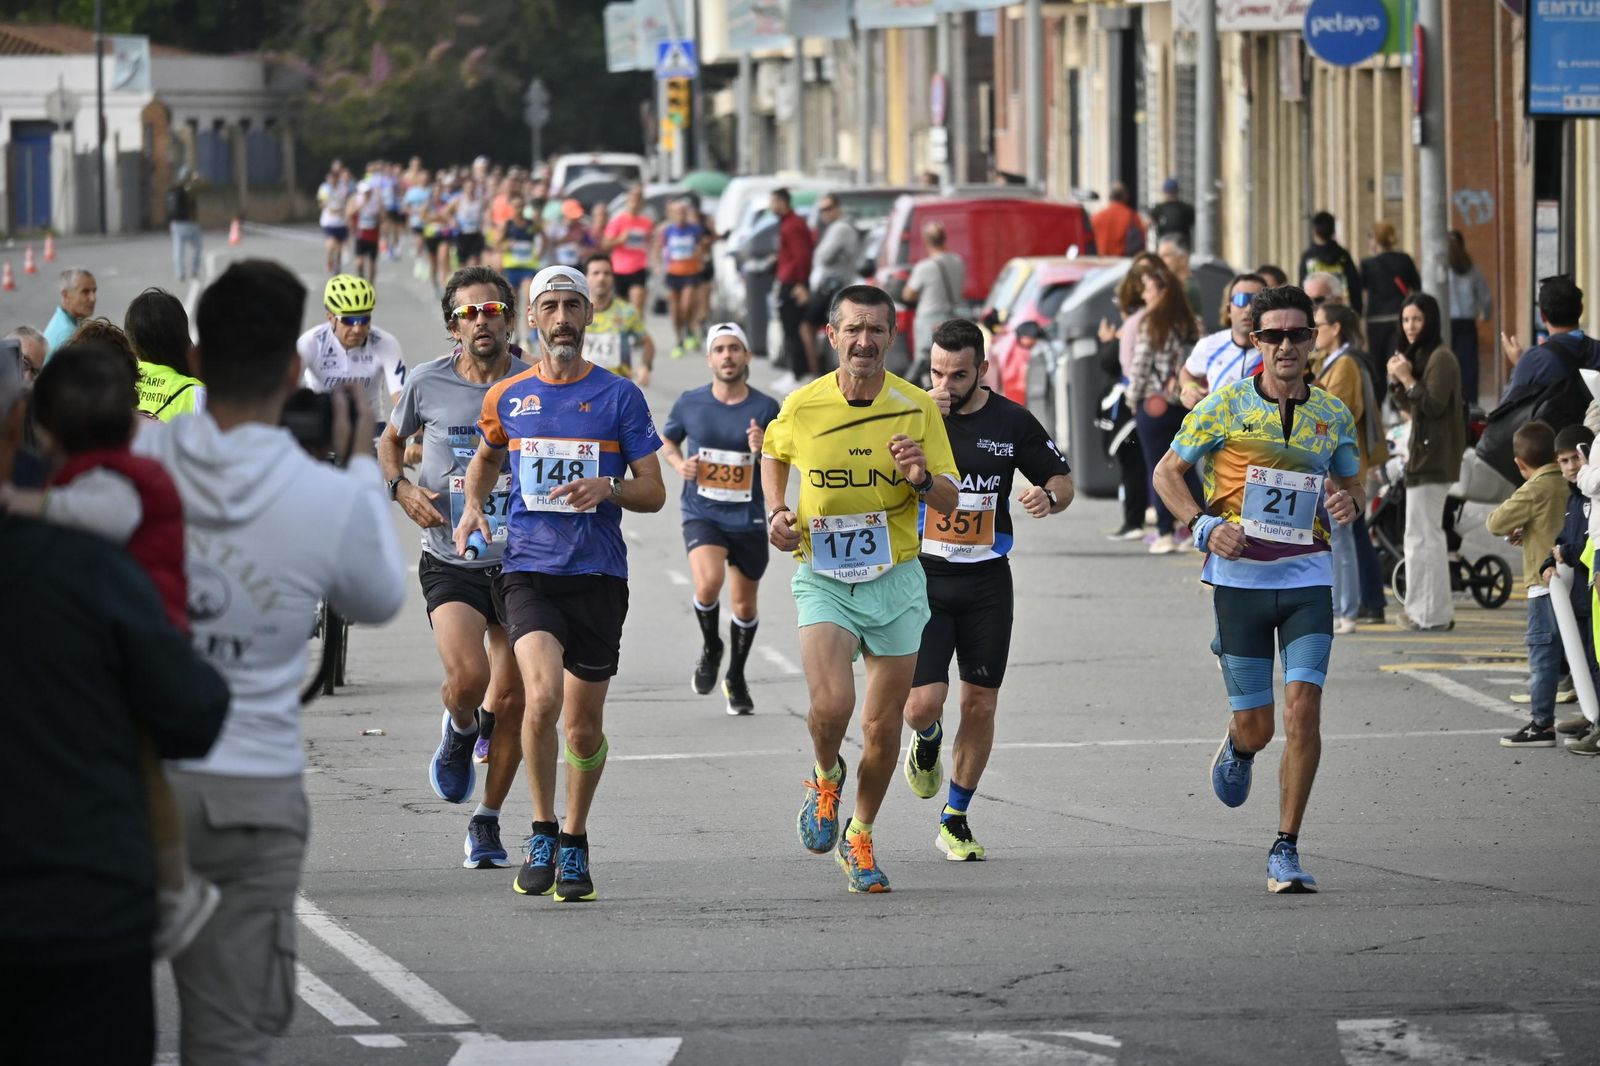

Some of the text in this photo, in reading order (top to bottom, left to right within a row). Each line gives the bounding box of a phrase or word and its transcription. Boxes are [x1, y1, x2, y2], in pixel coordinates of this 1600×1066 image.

[1311, 12, 1380, 37] pelayo
[849, 448, 873, 456] vive
[531, 458, 584, 485] 148
[706, 463, 744, 483] 239
[1263, 488, 1297, 516] 21
[936, 510, 982, 535] 351
[1259, 523, 1293, 537] Huelva
[824, 529, 877, 559] 173
[940, 543, 973, 554] Huelva
[833, 568, 868, 579] Huelva
